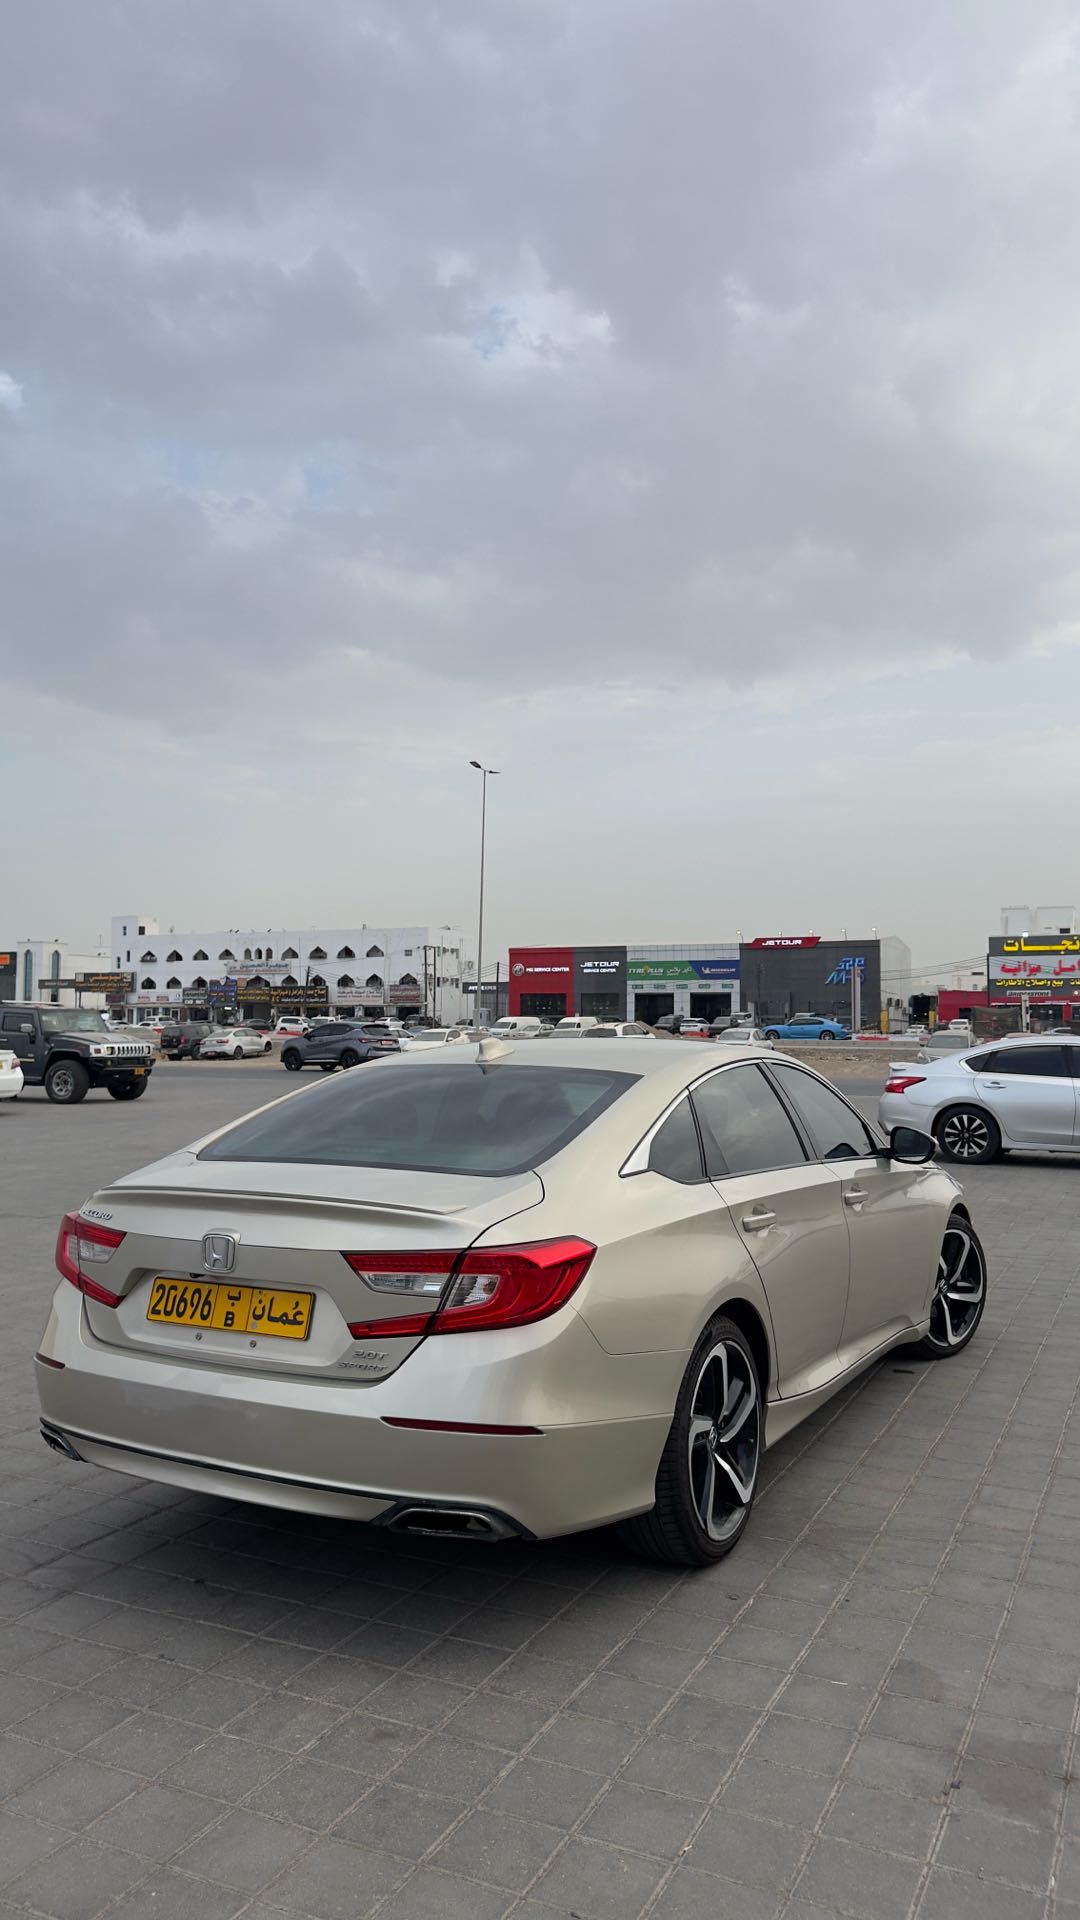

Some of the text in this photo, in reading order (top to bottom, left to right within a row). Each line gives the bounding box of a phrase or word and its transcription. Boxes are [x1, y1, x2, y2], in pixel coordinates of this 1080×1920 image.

[150, 1283, 213, 1322] 20696
[223, 1310, 236, 1328] B
[353, 1350, 390, 1361] 2.0T
[337, 1361, 389, 1371] SPORT
